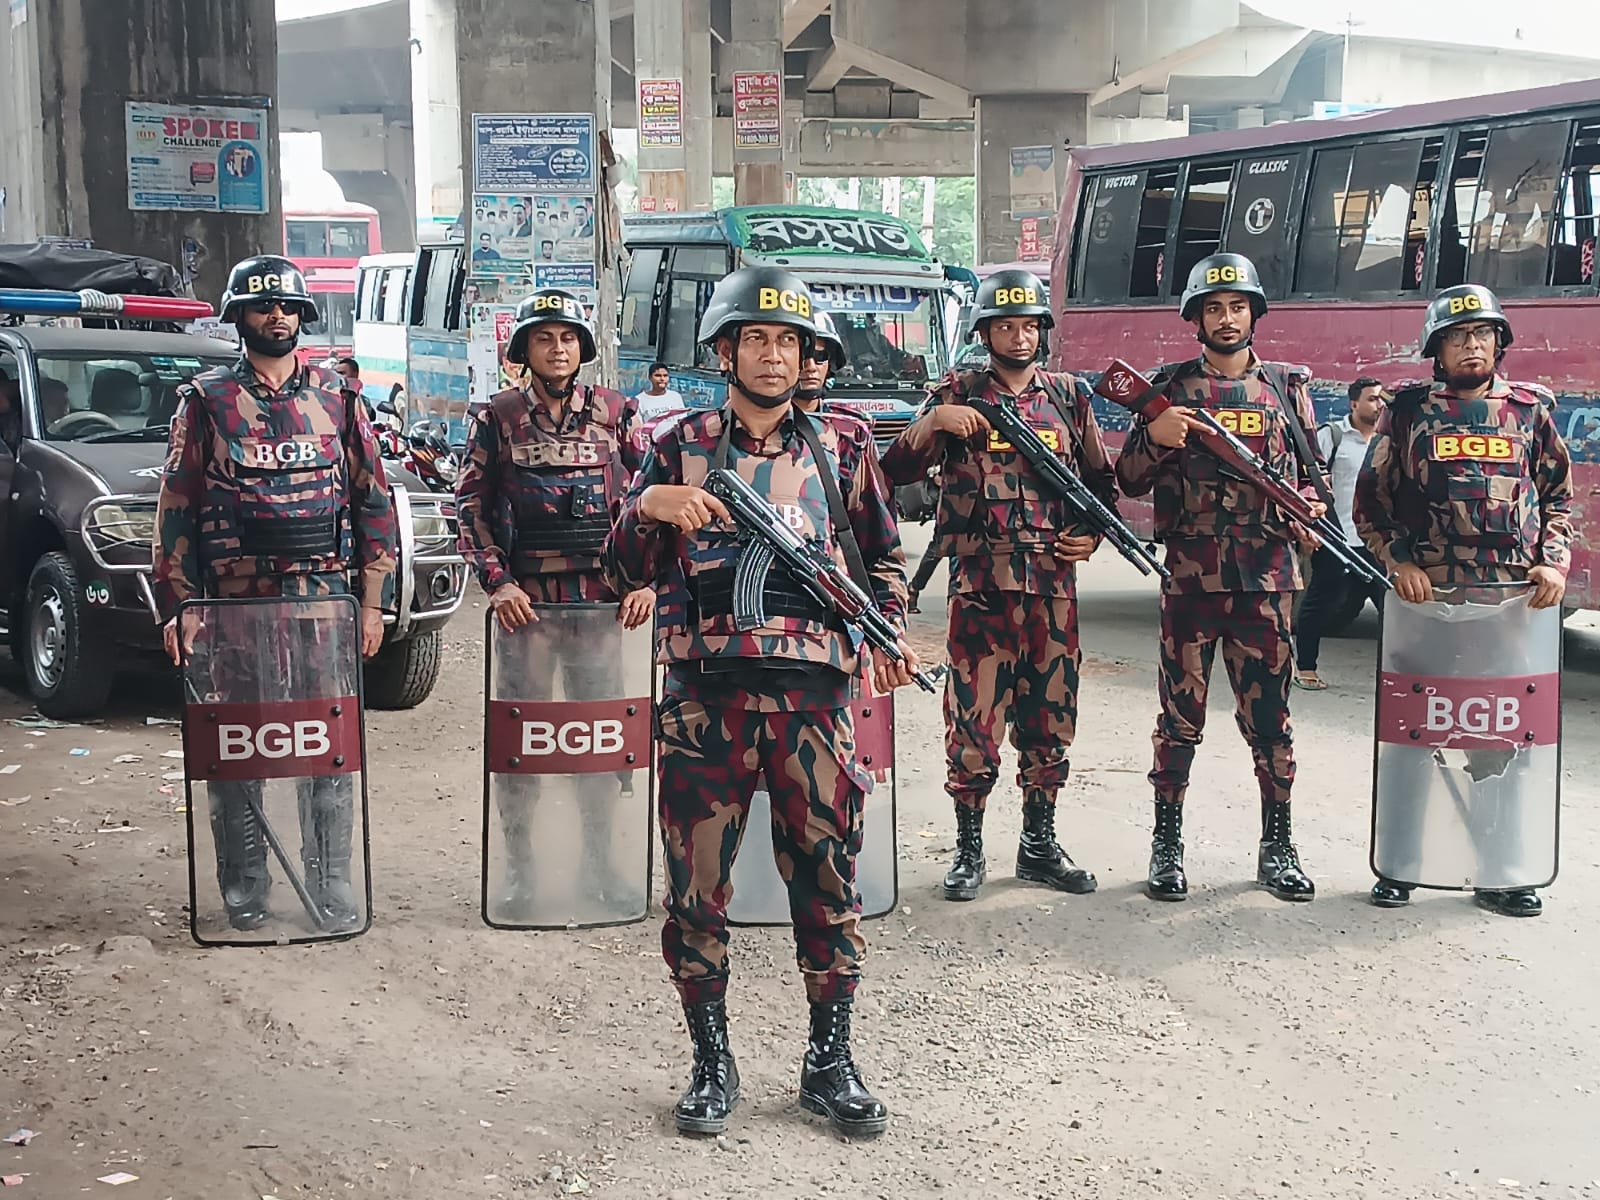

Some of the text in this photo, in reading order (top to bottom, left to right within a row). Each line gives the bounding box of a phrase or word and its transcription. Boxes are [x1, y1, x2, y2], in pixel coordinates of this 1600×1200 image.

[163, 137, 222, 148] CHALLENGE
[1249, 160, 1289, 175] CLASSIC
[1105, 174, 1138, 189] VICTOR
[248, 273, 295, 293] BGB
[1206, 266, 1249, 284] BGB
[534, 295, 576, 311] BGB
[759, 287, 810, 318] BGB
[995, 287, 1037, 306] BGB
[1214, 411, 1262, 437] GB
[990, 427, 1059, 449] BB
[1436, 436, 1512, 458] BGB
[255, 441, 317, 463] BGB
[528, 442, 598, 465] BGB
[1426, 696, 1521, 732] BGB
[218, 719, 331, 760] BGB
[522, 719, 624, 755] BGB
